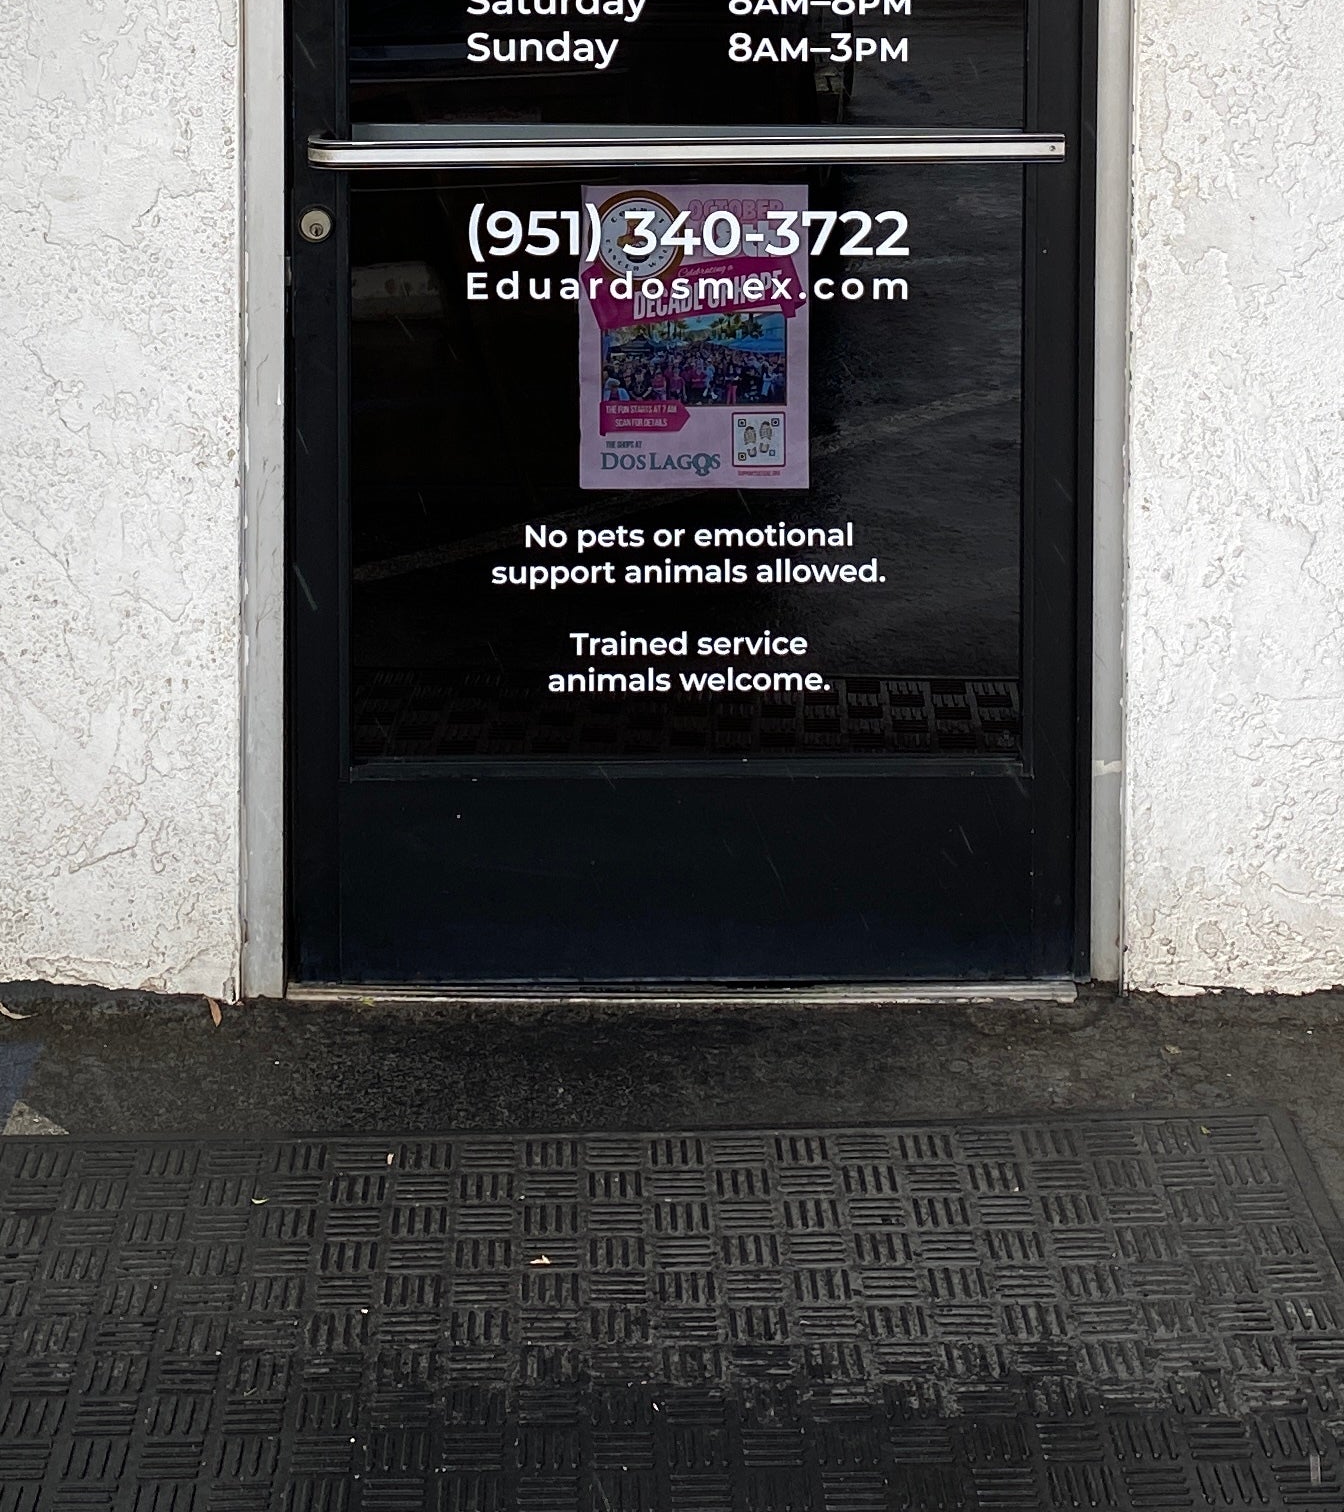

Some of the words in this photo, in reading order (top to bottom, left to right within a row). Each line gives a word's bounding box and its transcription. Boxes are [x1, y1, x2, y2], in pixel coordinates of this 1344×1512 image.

[467, 30, 619, 69] Sunday
[468, 203, 602, 263] (951)
[622, 210, 910, 257] 340-3722
[466, 270, 909, 300] Eduardosmex.com
[600, 452, 647, 470] DOS
[649, 452, 721, 476] LAGOS
[524, 524, 568, 548] No
[576, 524, 646, 554] pets
[652, 528, 686, 548] or
[693, 521, 854, 548] emotional
[490, 560, 616, 590] support
[623, 558, 749, 585] animals
[755, 557, 887, 584] allowed.
[568, 630, 689, 657] Trained
[696, 630, 809, 657] service
[547, 666, 671, 693] animals
[678, 666, 831, 693] welcome.
